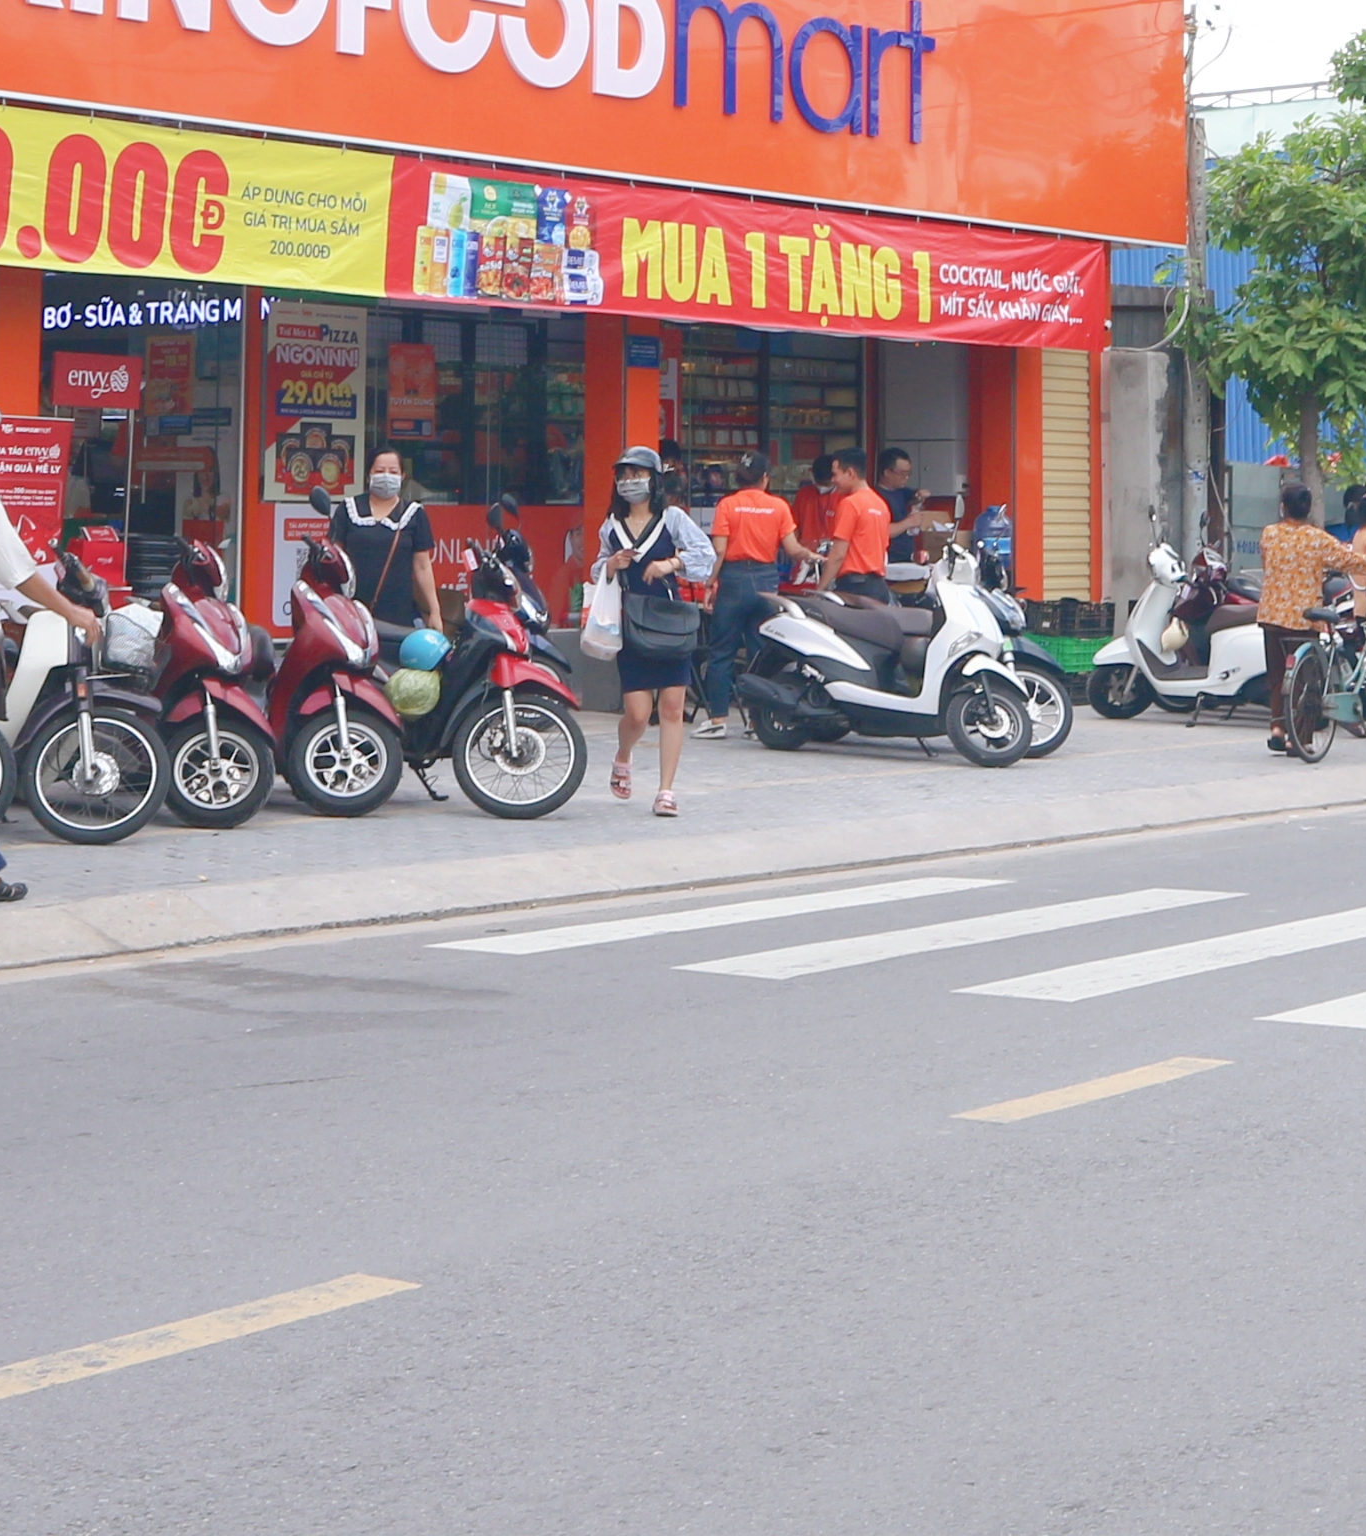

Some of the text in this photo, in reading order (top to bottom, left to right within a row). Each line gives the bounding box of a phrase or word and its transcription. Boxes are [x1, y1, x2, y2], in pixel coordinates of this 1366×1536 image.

[241, 181, 367, 212] ÁP DỤNG CHO MỖI
[243, 209, 360, 236] GIÁ TRỊ MUA SẮM
[270, 240, 331, 259] 200.000Đ
[621, 217, 932, 326] MUA 1 TẶNG 1
[939, 264, 1009, 292] COCKTAIL,
[1011, 268, 1052, 292] NƯỚC
[43, 302, 72, 329] BƠ
[84, 296, 126, 328] SỮA
[128, 303, 143, 325] &
[146, 291, 221, 325] TRÁNG
[940, 291, 966, 316] MÍT
[999, 297, 1040, 321] KHĂN
[275, 344, 359, 367] NGONNN!
[8, 445, 23, 456] TÁO
[14, 462, 33, 473] QUÀ
[35, 463, 49, 474] MÊ
[50, 465, 62, 474] LY
